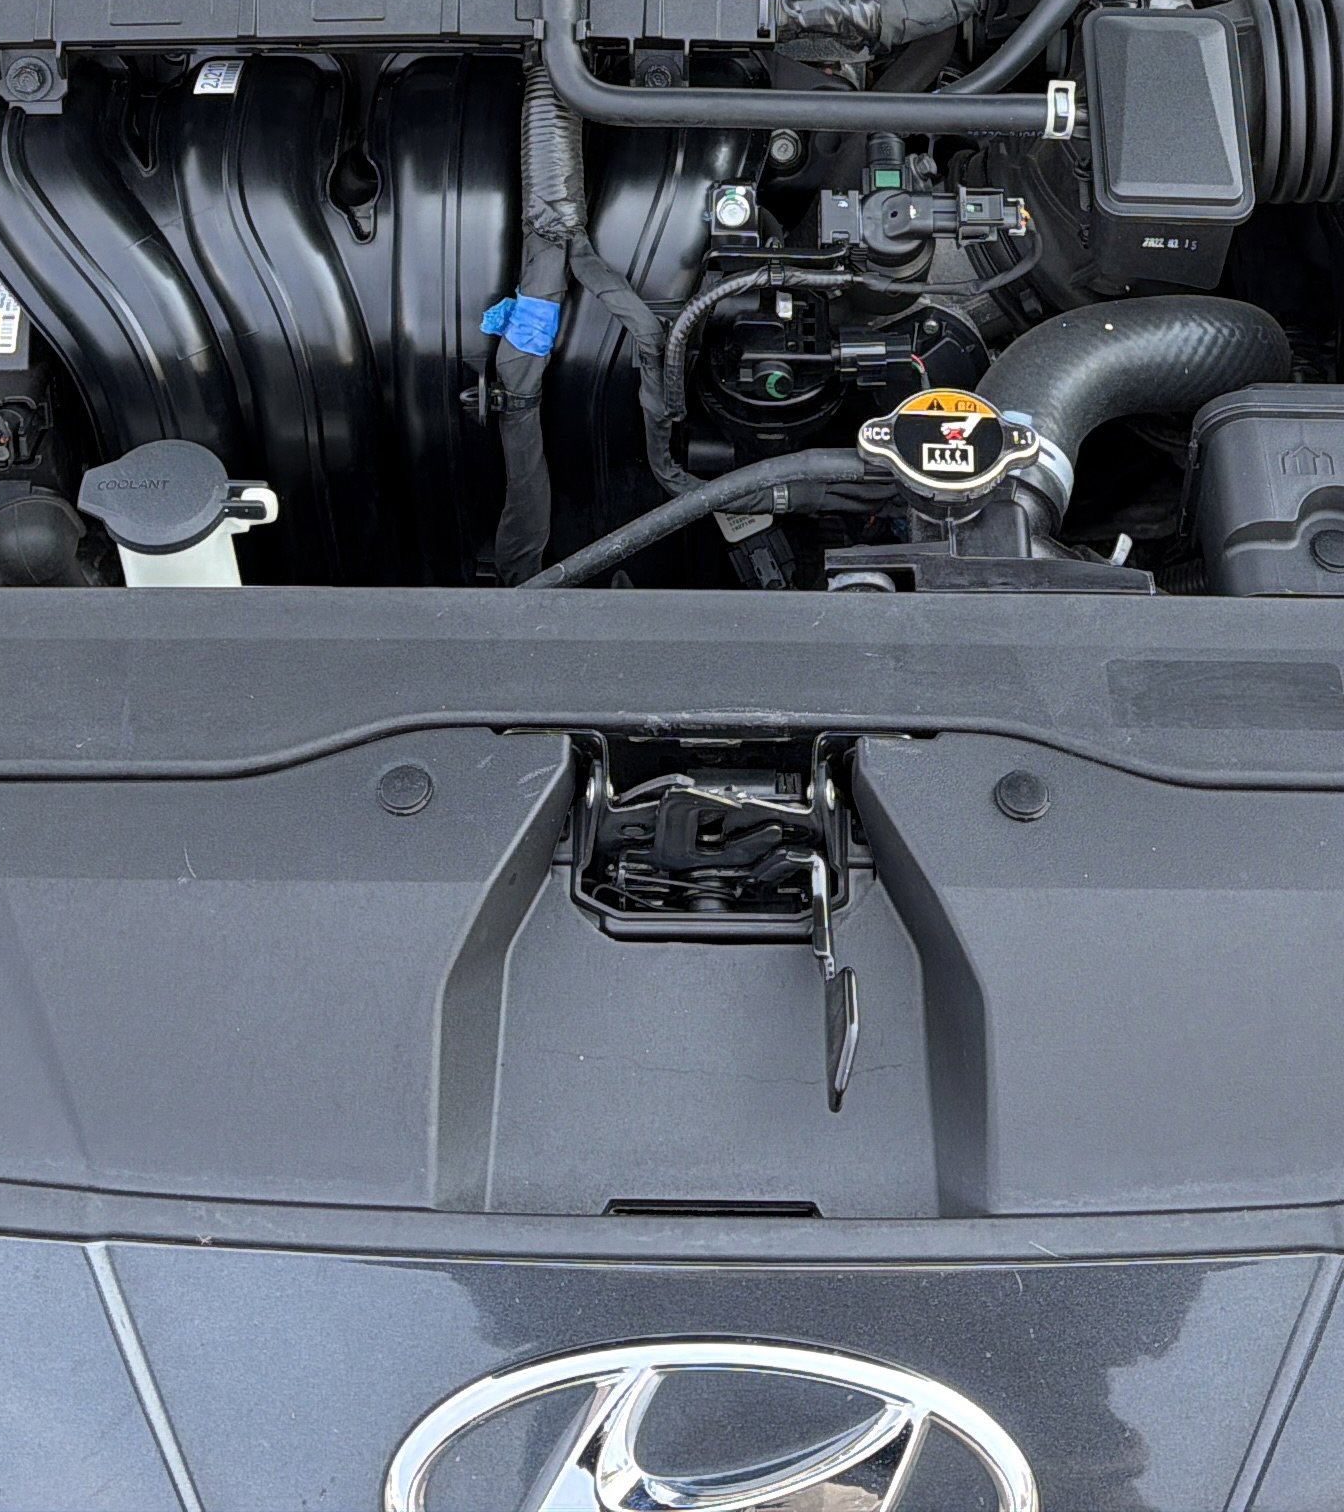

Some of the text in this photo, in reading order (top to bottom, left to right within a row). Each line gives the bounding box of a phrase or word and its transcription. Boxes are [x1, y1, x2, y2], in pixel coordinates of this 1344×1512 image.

[200, 63, 227, 89] 2J210
[863, 427, 1033, 445] HCC 1.1
[96, 479, 170, 492] COOLANT
